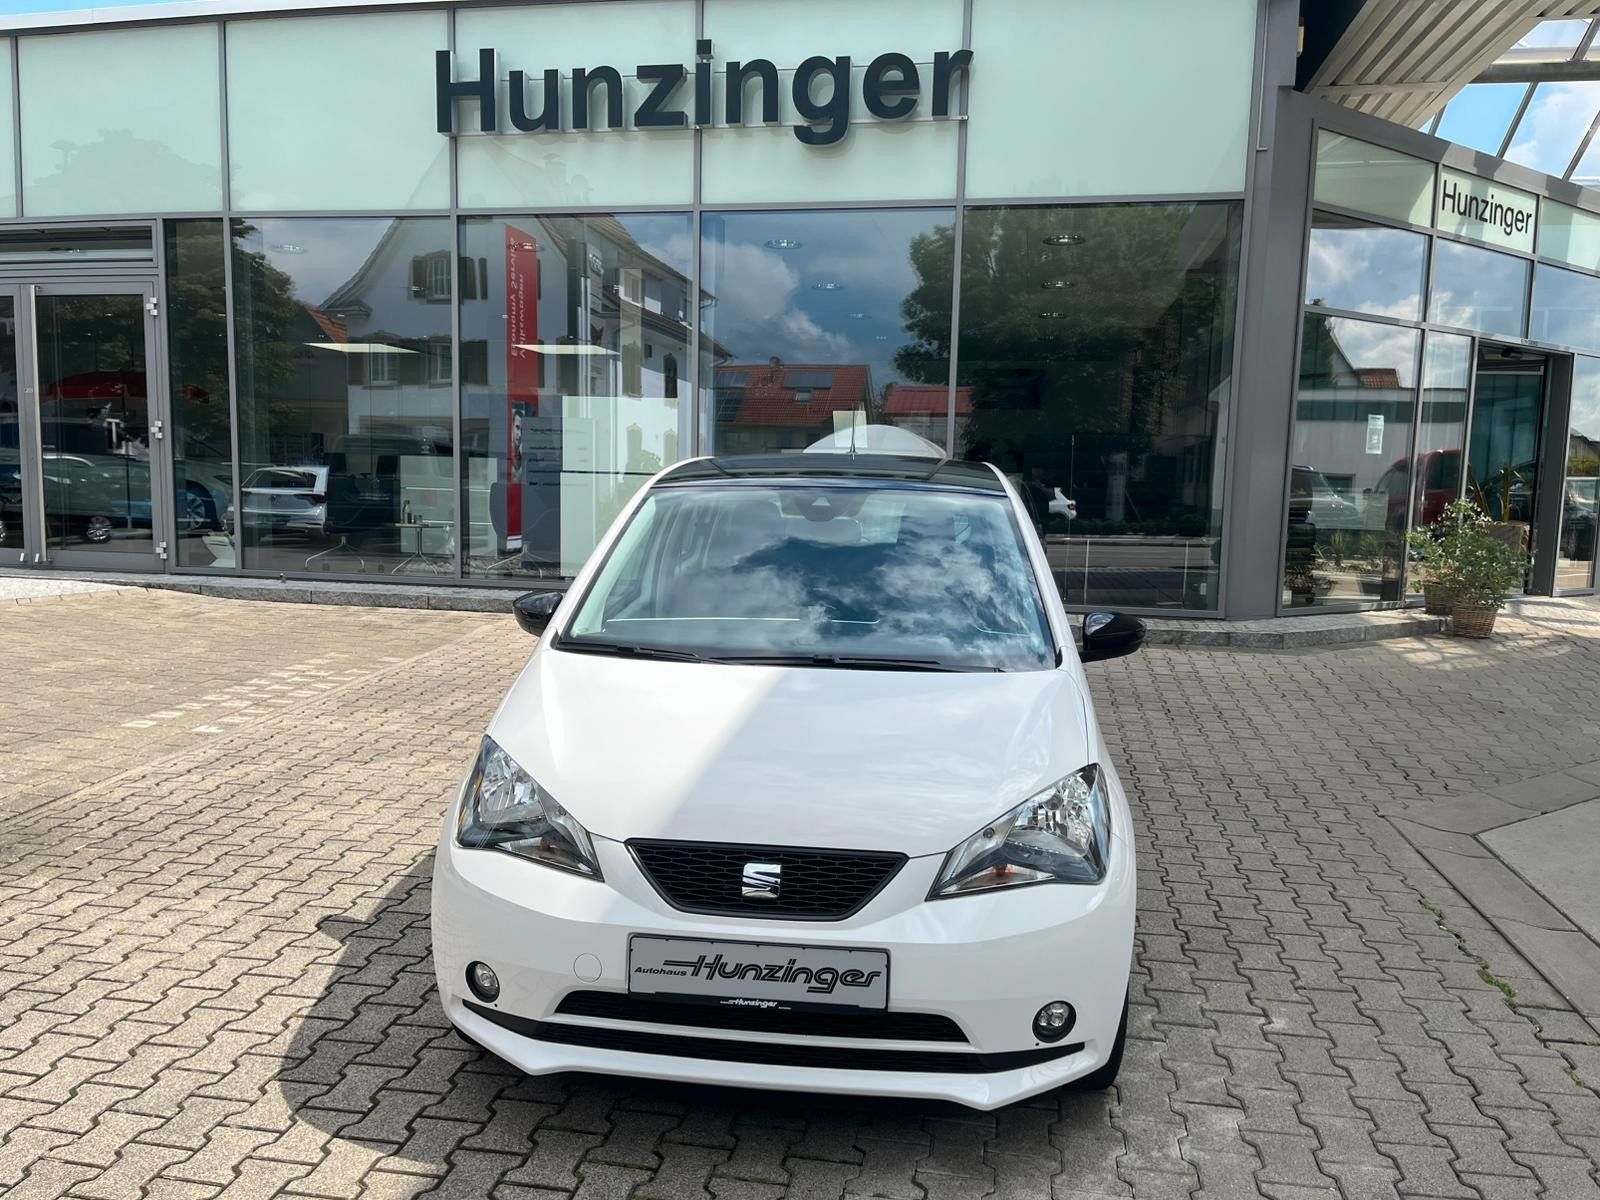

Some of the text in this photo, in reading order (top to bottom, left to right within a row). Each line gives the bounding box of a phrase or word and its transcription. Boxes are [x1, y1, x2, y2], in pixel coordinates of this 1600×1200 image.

[436, 39, 974, 146] Hunzinger
[1441, 179, 1533, 236] Hunzinger
[634, 954, 882, 994] Autohaus Hunzinger
[730, 998, 778, 1009] Hunzinger
